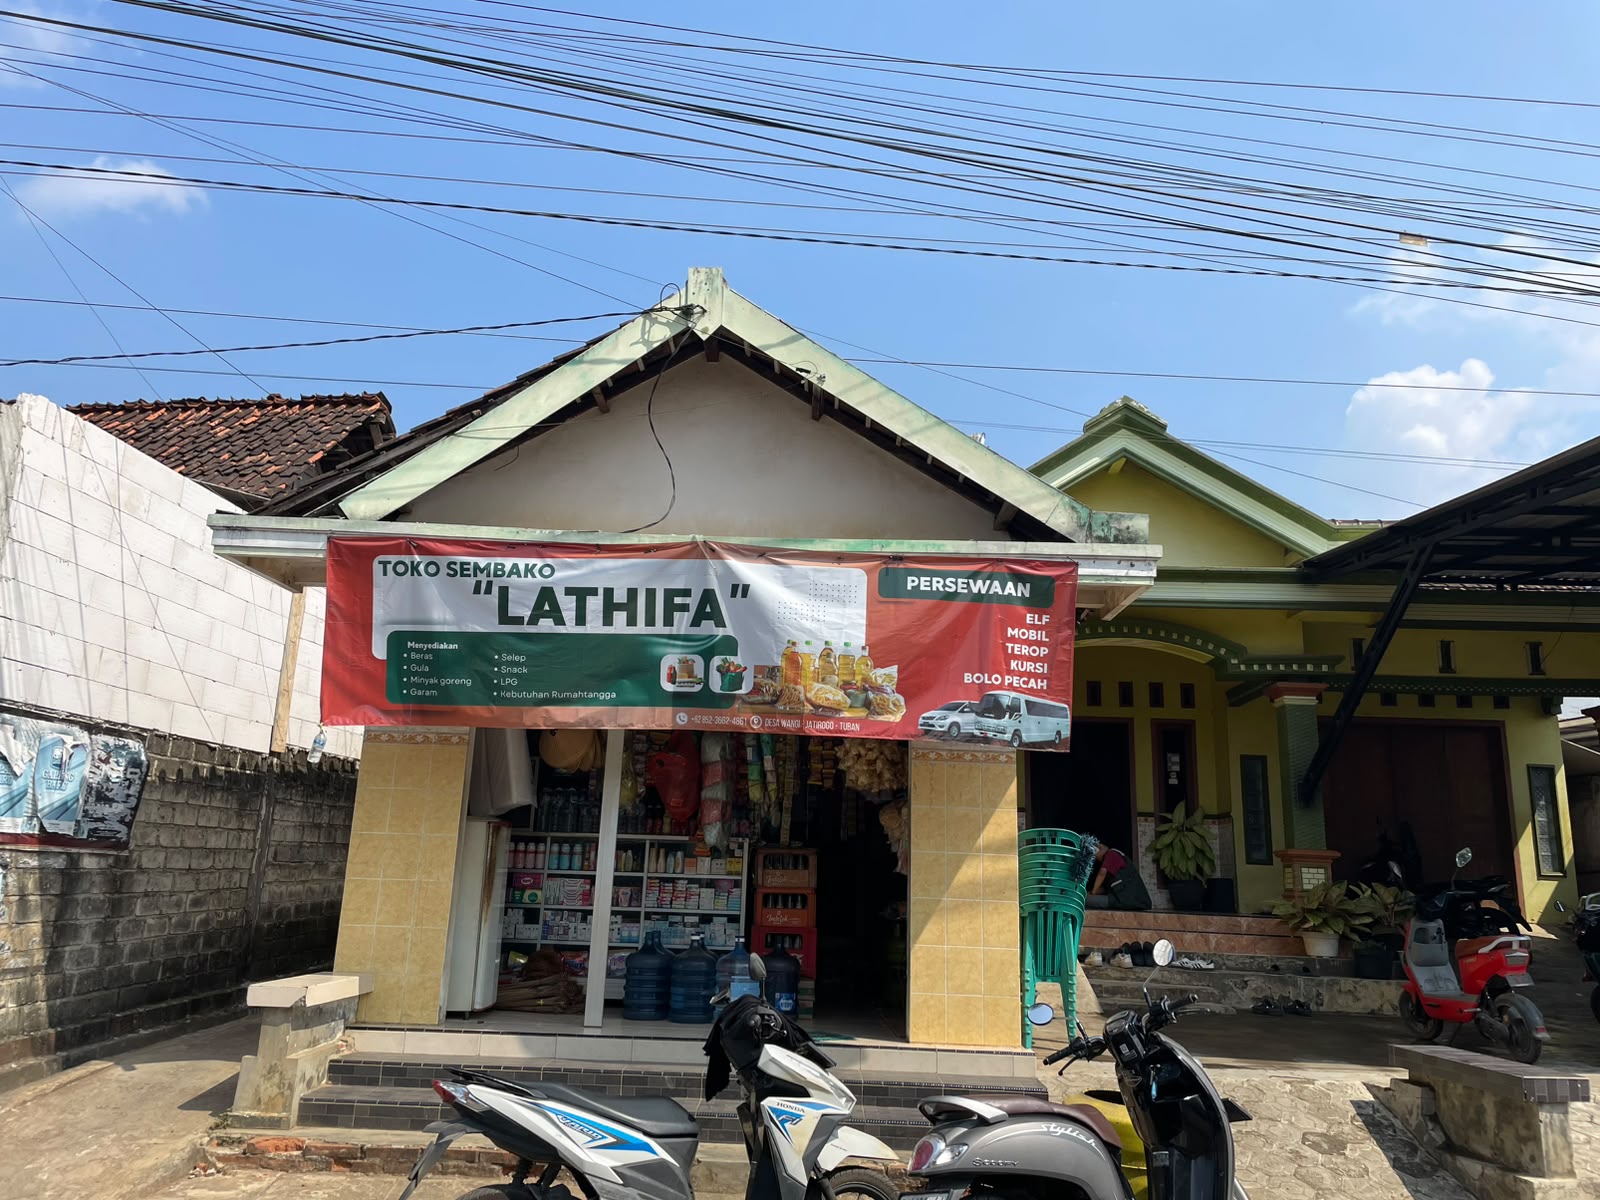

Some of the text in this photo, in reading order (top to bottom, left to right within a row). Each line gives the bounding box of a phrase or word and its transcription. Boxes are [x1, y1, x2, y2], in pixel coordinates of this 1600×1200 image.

[378, 560, 556, 579] TOKO SEMBAKO
[906, 576, 1031, 598] PERSEWAAN
[1025, 613, 1050, 625] ELF
[1007, 627, 1050, 642] MOBIL
[407, 641, 459, 651] Menyediakan
[1005, 642, 1049, 657] TEROP
[410, 651, 433, 660] Beras
[501, 653, 526, 663] Selep
[410, 663, 429, 672] Gula
[500, 665, 528, 674] Snack
[1010, 659, 1048, 674] KURSI
[410, 676, 472, 687] Minyak goreng
[500, 678, 518, 686] LPG
[963, 672, 1047, 690] BOLO PECAH
[409, 688, 438, 696] Garam
[500, 690, 617, 700] Kebutuhan Rumahtangga
[764, 718, 780, 727] DESA
[804, 720, 834, 730] JATIROGO
[839, 722, 860, 731] TUBAN
[776, 1102, 805, 1113] HONDA
